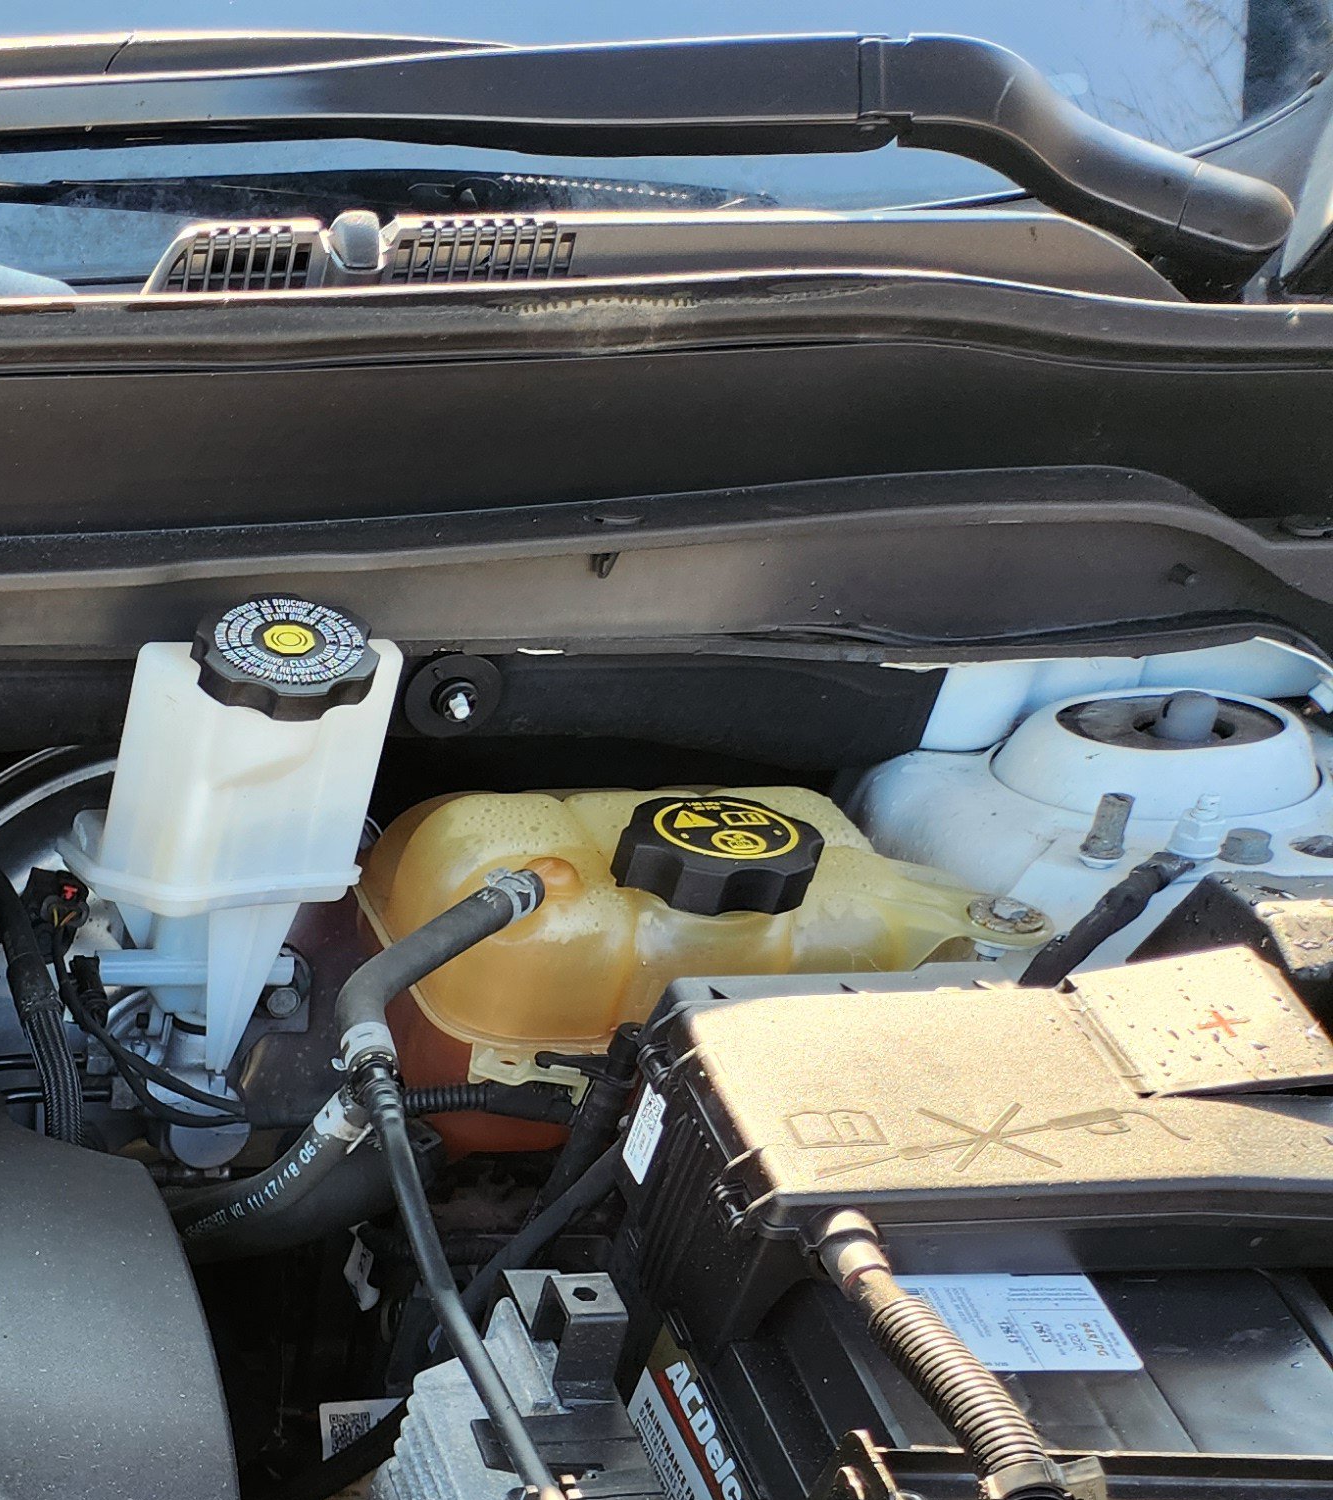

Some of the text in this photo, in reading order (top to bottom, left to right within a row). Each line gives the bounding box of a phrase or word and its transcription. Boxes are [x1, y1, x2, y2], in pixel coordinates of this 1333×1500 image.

[247, 1161, 301, 1212] 11/17/18
[639, 1405, 665, 1460] BATTERIE
[661, 1456, 679, 1491] SANS
[643, 1396, 687, 1486] MAINTENANCE
